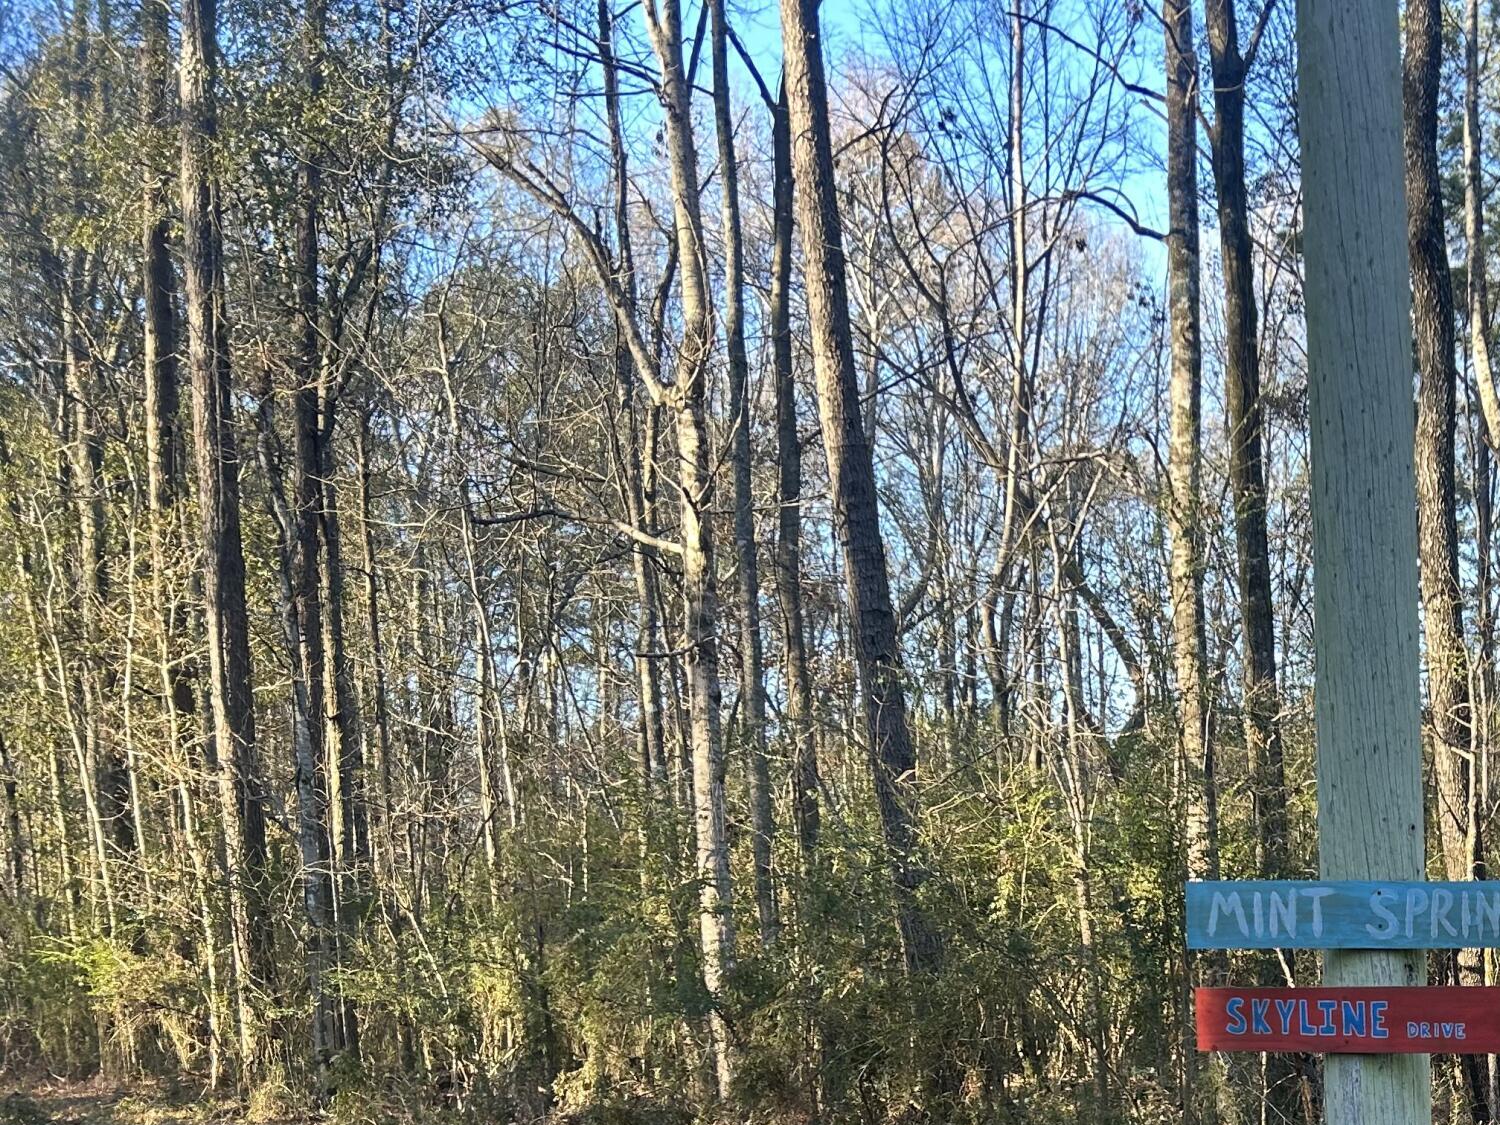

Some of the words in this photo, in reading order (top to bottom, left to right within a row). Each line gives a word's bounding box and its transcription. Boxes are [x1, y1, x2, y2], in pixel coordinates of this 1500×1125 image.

[1207, 886, 1336, 940] MINT
[1225, 996, 1389, 1039] SKYLINE
[1406, 1021, 1467, 1040] DRIVE
